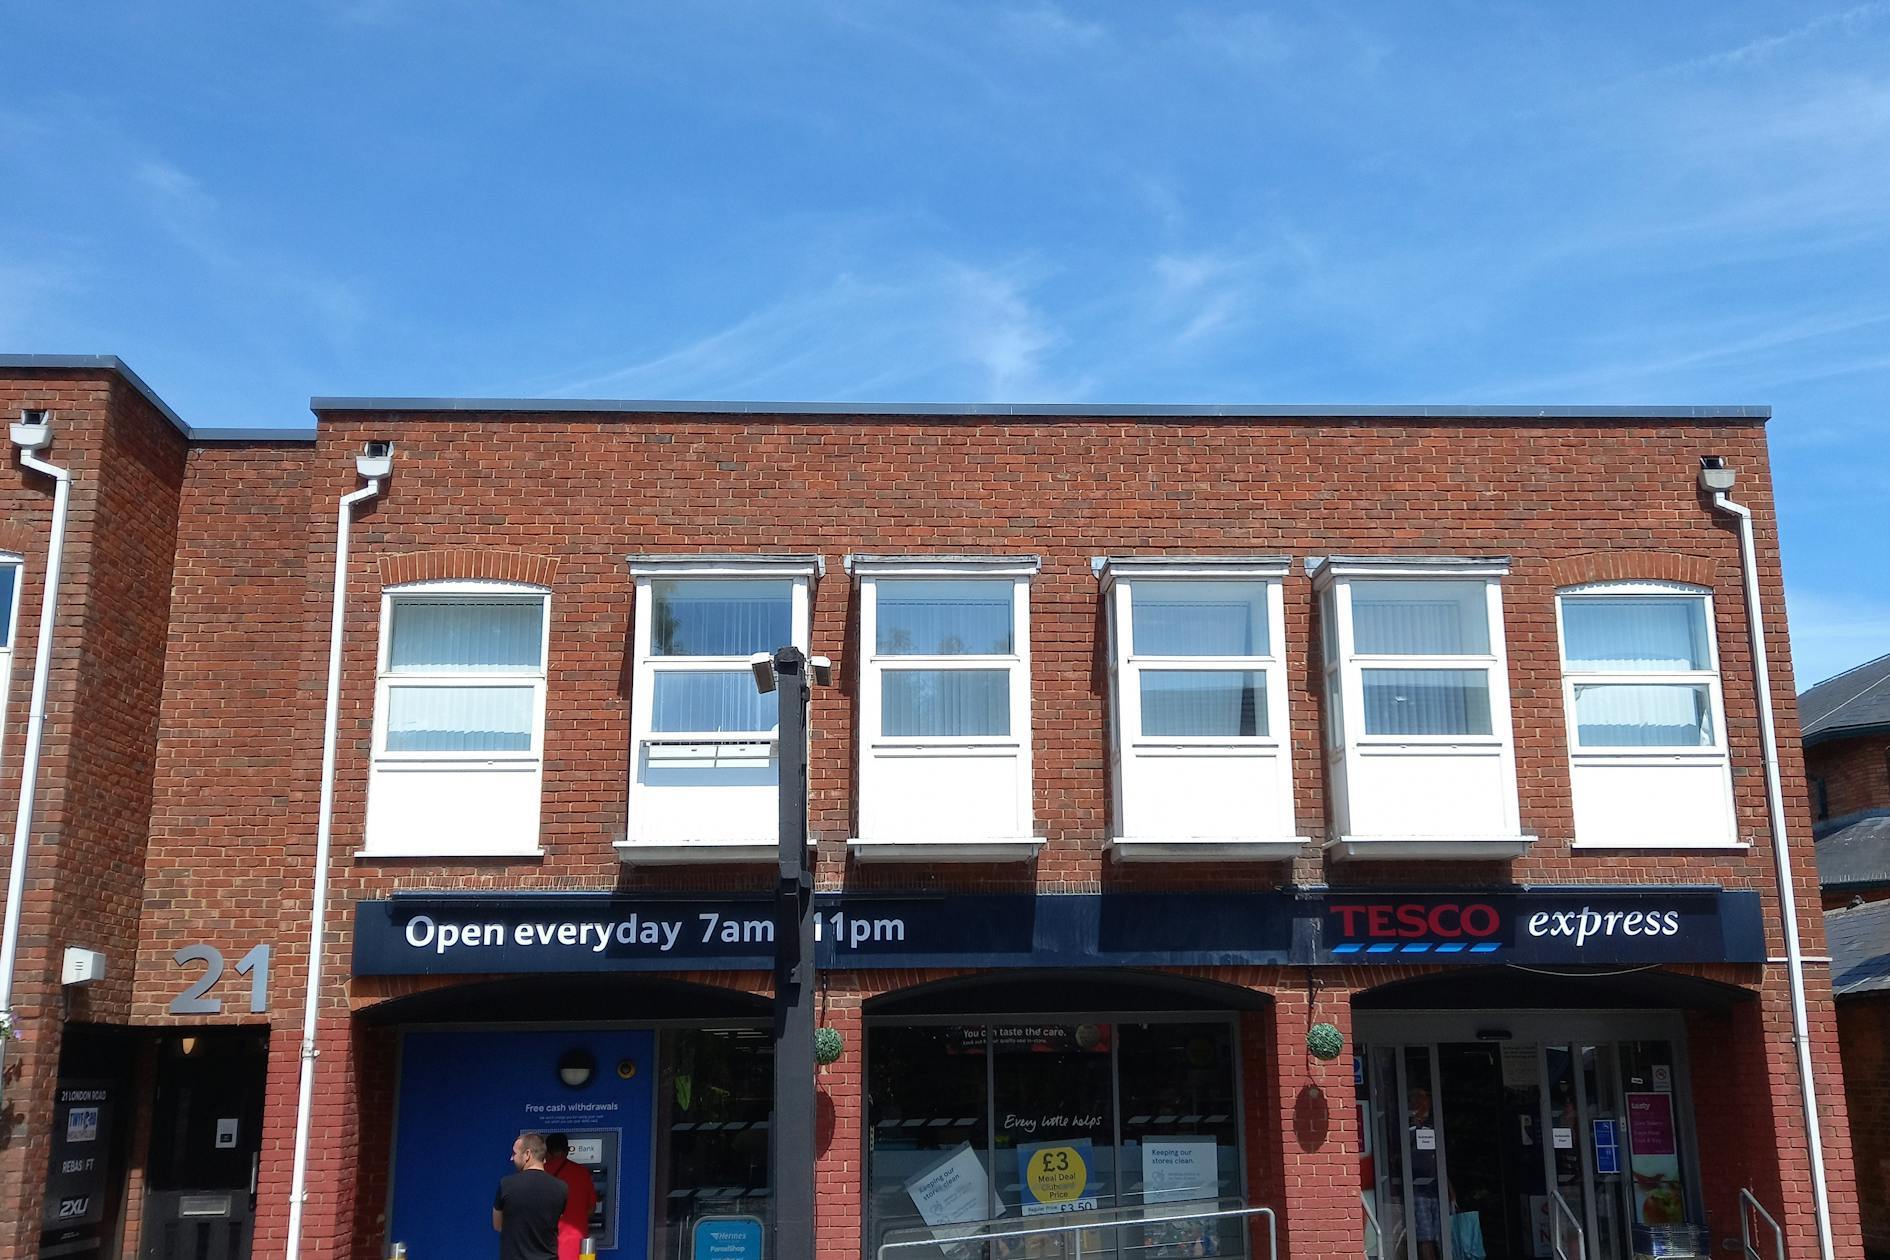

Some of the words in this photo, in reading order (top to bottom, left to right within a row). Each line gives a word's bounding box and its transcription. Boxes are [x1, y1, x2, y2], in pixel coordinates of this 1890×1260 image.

[1329, 904, 1501, 938] TESCO
[1528, 906, 1680, 947] express
[405, 915, 504, 954] Open
[514, 913, 683, 953] everyday
[699, 913, 775, 944] 7am
[813, 911, 905, 949] 11pm
[169, 943, 270, 1014] 21
[963, 1029, 980, 1038] You
[981, 1029, 997, 1038] cn
[1000, 1027, 1023, 1037] taste
[1025, 1027, 1042, 1037] the
[68, 1090, 92, 1101] LONDON
[525, 1103, 545, 1112] Free
[546, 1103, 566, 1112] cash
[568, 1102, 618, 1112] withdrawals
[1004, 1114, 1037, 1133] Every
[1041, 1115, 1068, 1127] little
[1072, 1115, 1102, 1129] helps
[578, 1144, 595, 1153] Bank
[1152, 1149, 1179, 1157] Keeping
[1042, 1151, 1069, 1172] £3
[943, 1167, 954, 1178] our
[1038, 1175, 1057, 1184] Meal
[1058, 1172, 1076, 1181] Deal
[923, 1185, 943, 1201] stor
[1049, 1190, 1069, 1199] Price
[59, 1198, 89, 1218] 2XU
[1060, 1202, 1092, 1213] £350
[719, 1232, 747, 1240] Hermes
